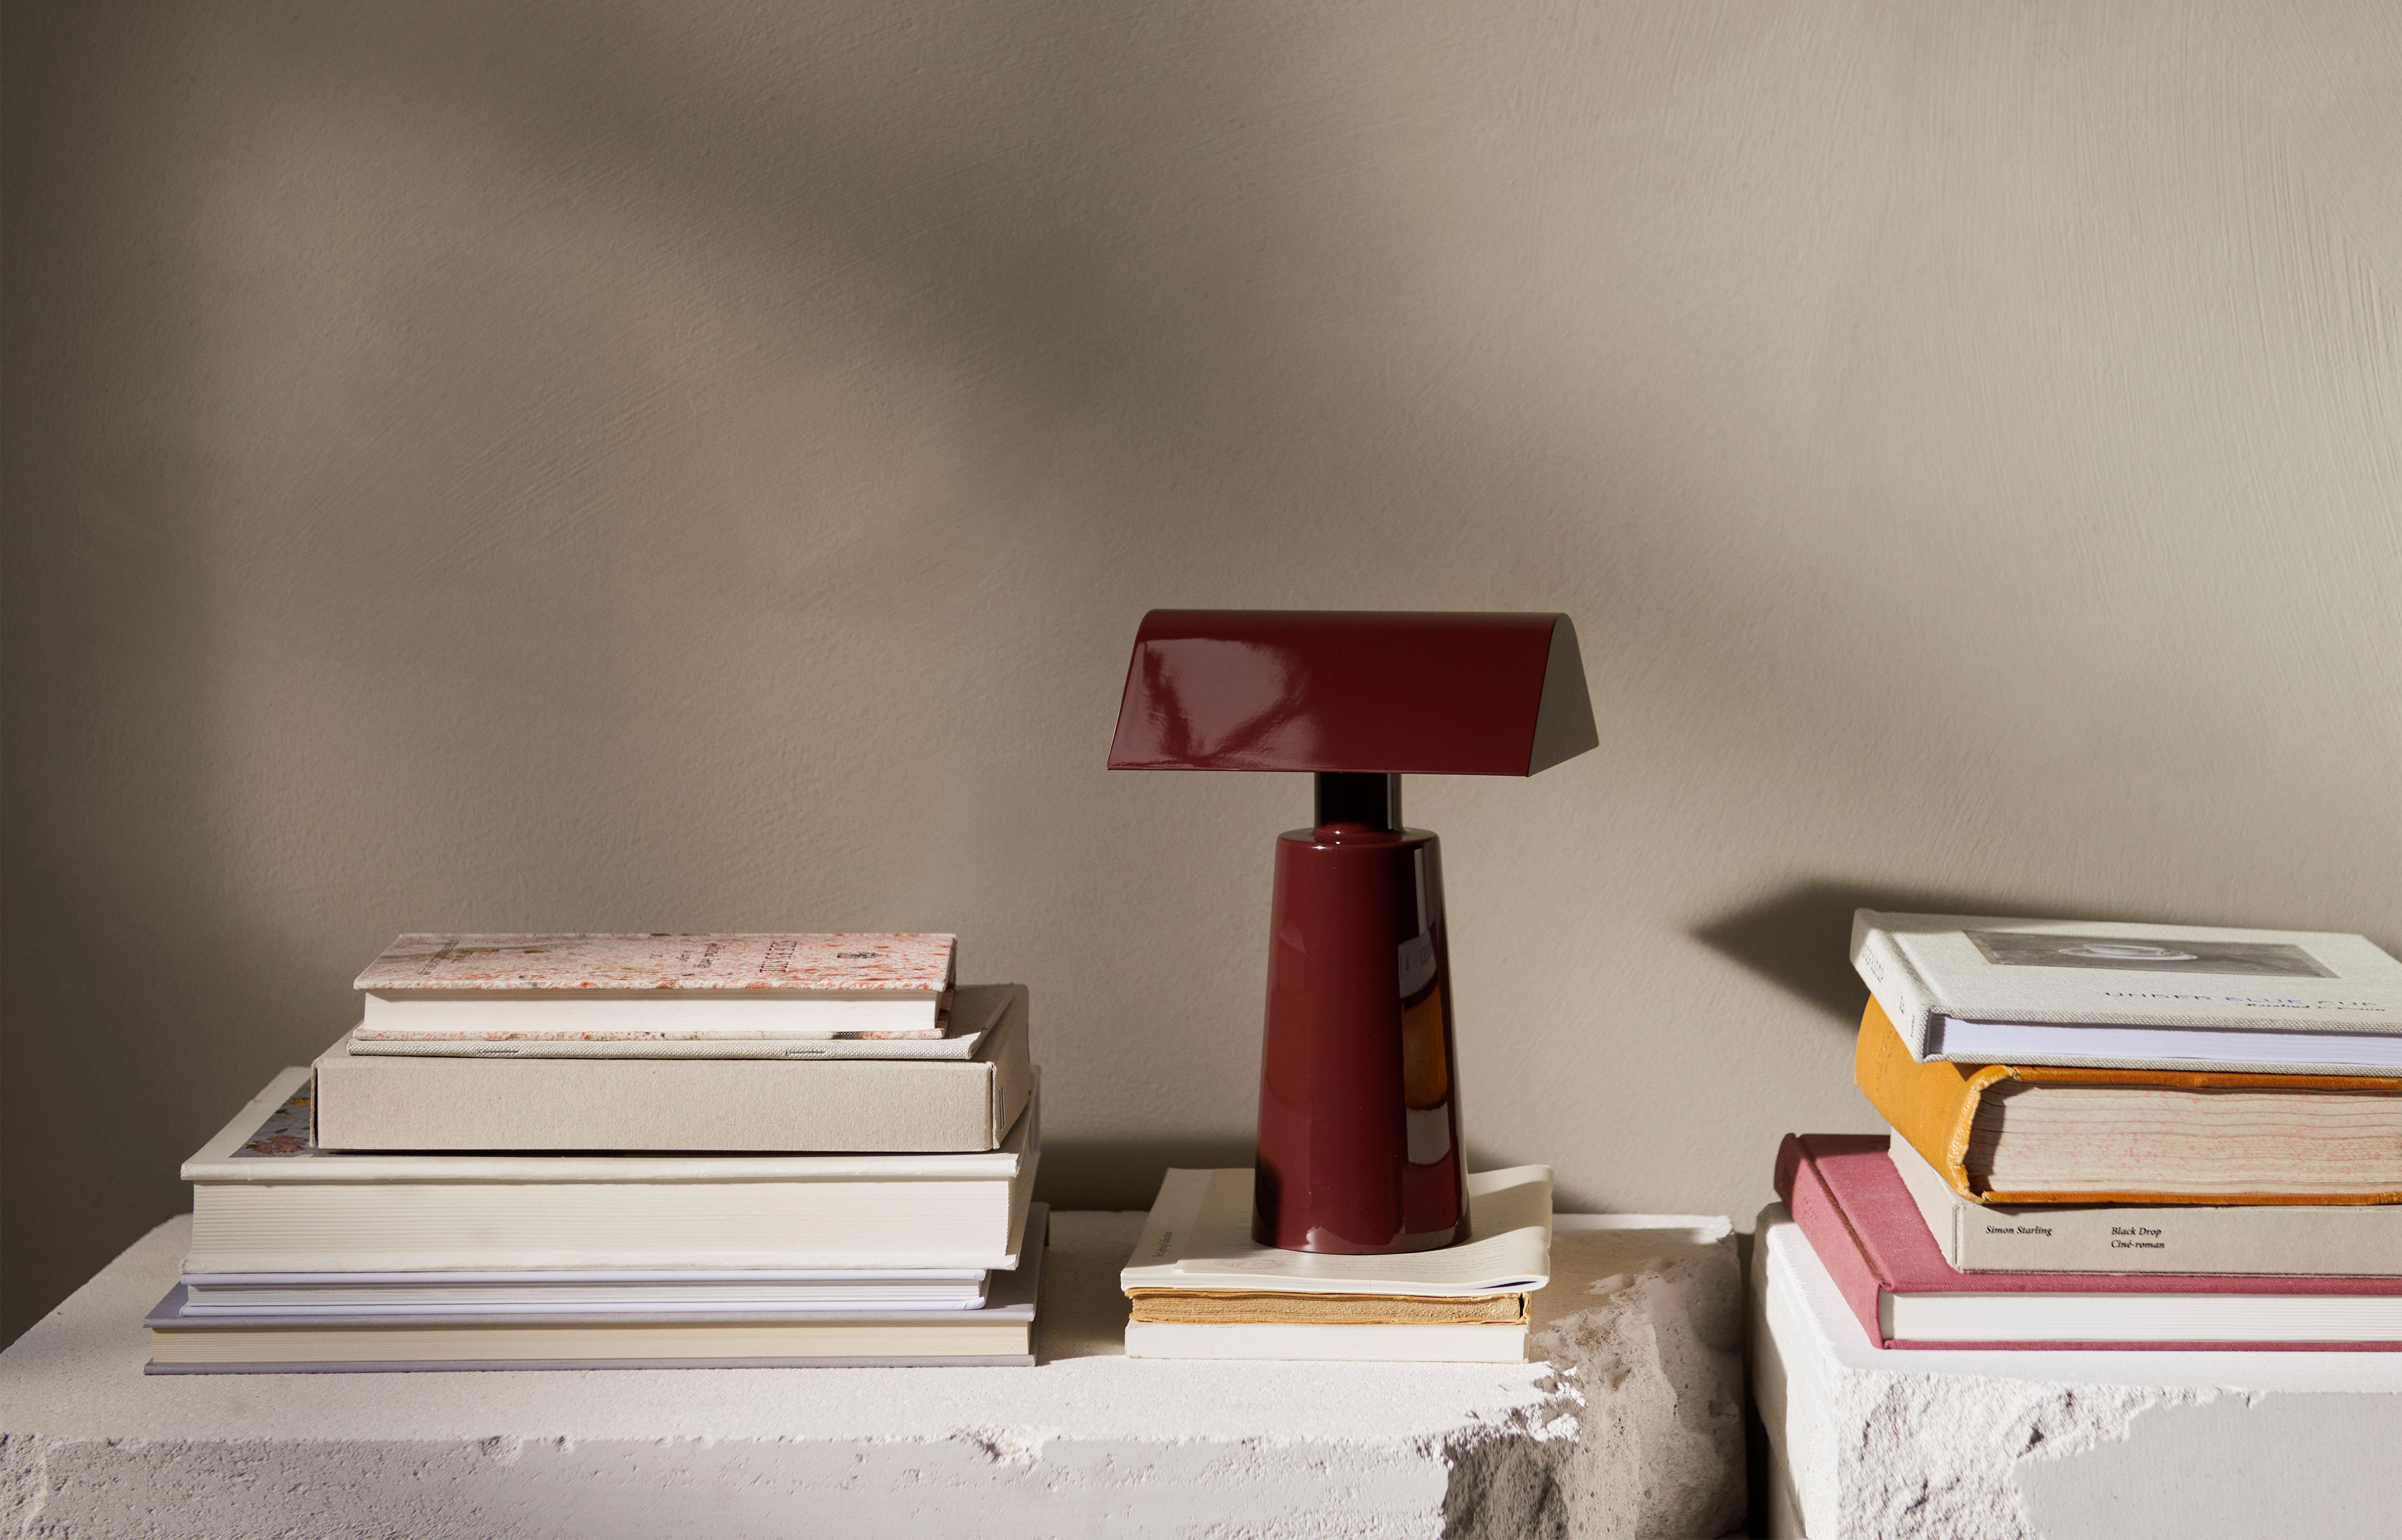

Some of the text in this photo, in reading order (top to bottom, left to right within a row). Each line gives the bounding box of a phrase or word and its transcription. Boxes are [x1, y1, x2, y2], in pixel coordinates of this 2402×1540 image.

[2105, 992, 2212, 1000] UNDER
[1986, 1226, 2052, 1236] Simon Starling
[2111, 1226, 2162, 1237] Black Drop
[2111, 1239, 2165, 1249] Ciné-roman
